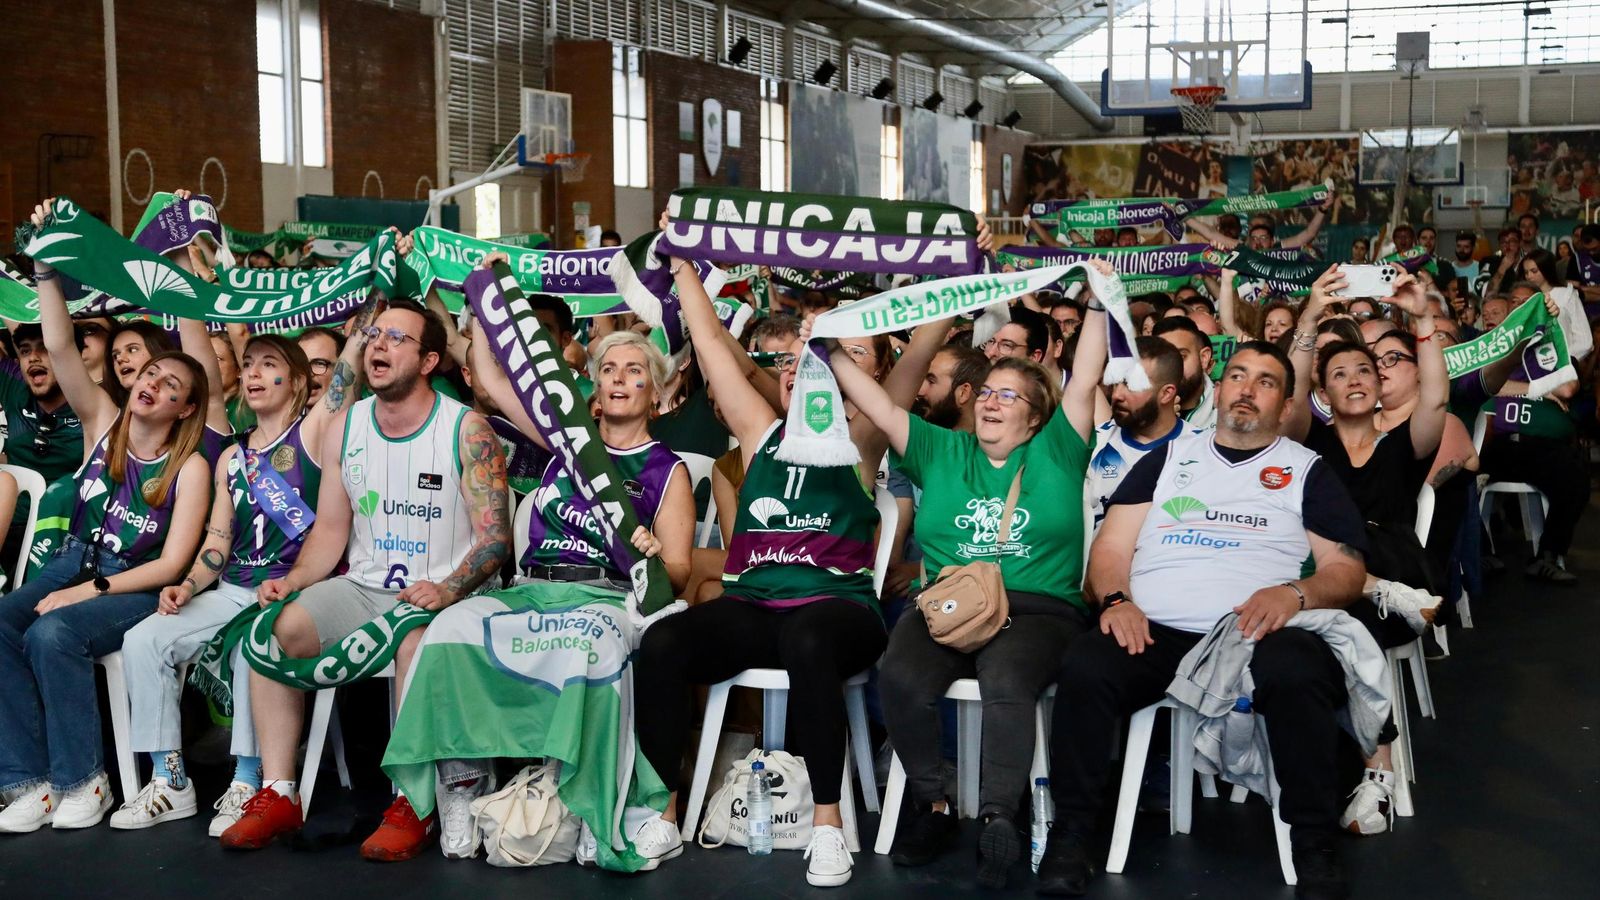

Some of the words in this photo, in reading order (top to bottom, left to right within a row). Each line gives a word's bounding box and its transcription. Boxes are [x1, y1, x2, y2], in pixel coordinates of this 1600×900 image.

[285, 222, 329, 237] UNICAJA
[665, 194, 967, 264] UNICAJA
[420, 230, 512, 267] Unica
[519, 274, 582, 287] ÁLAGA
[480, 274, 625, 549] UNICAJA
[1504, 402, 1532, 424] 05
[783, 466, 808, 500] 11
[102, 495, 159, 534] Unicaja
[383, 499, 442, 523] Unicaja
[556, 502, 602, 536] Unic
[785, 512, 832, 529] Unicaja
[1205, 509, 1269, 528] Unicaja
[1161, 528, 1241, 549] málaga
[747, 545, 818, 567] Andalucía
[527, 614, 605, 640] Unicaja
